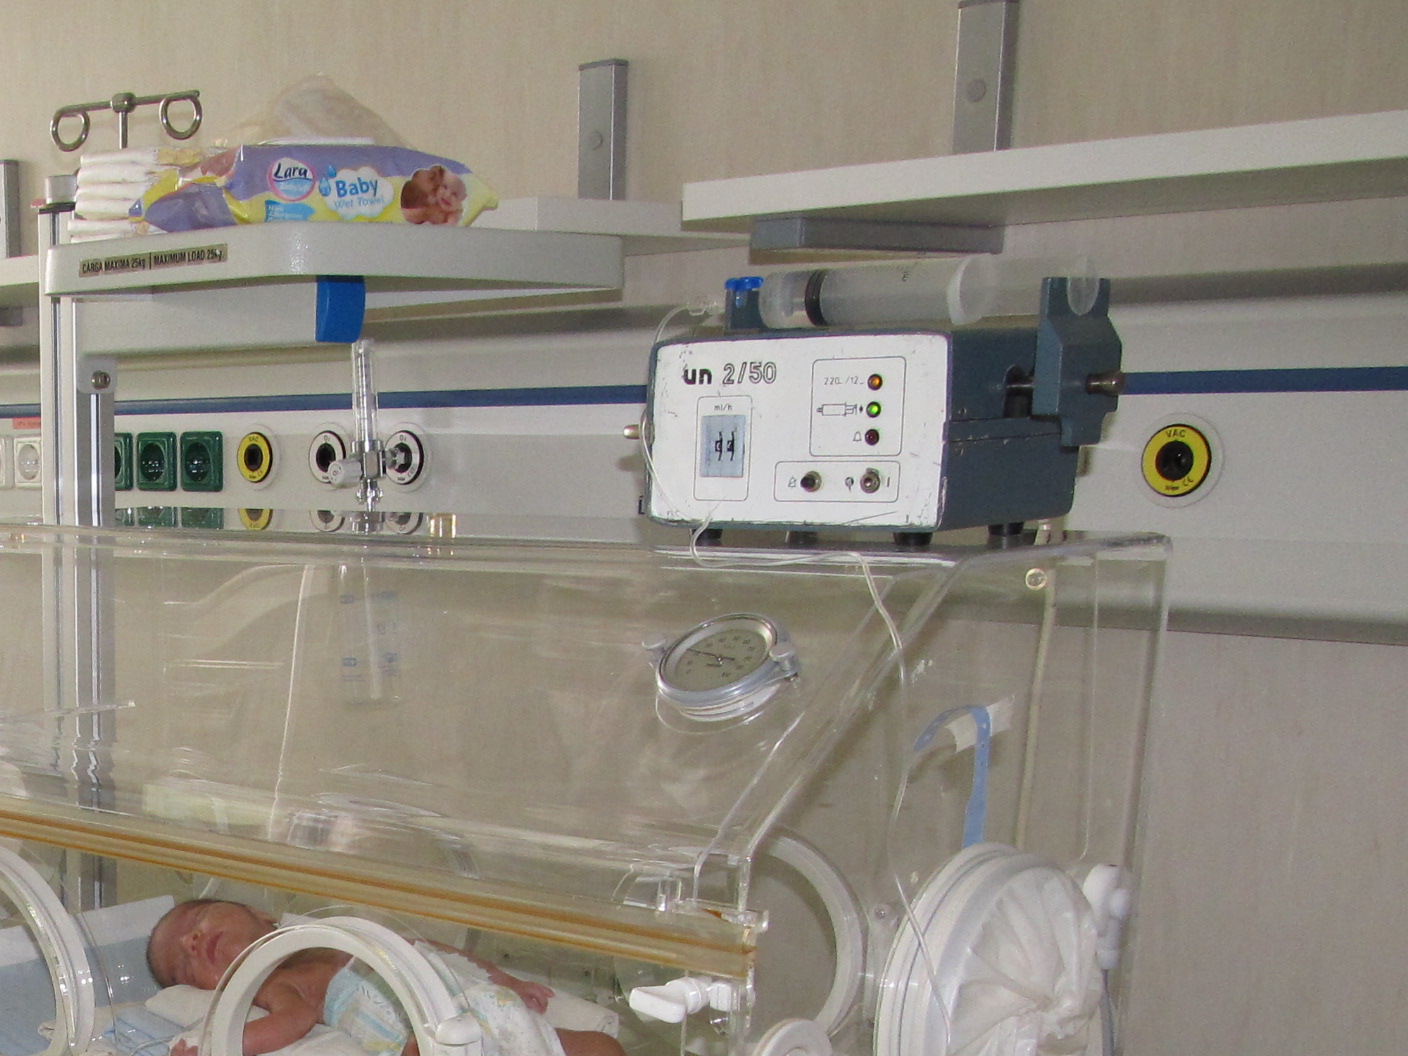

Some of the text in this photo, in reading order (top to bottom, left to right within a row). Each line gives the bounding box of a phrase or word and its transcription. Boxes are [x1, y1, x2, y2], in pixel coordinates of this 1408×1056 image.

[273, 162, 308, 179] Lara
[335, 177, 378, 198] Baby
[82, 262, 103, 273] CARGA
[104, 259, 130, 271] MAXIMA
[153, 252, 186, 266] MAXIMUM
[187, 250, 206, 262] LOAD
[722, 361, 777, 385] 2/50
[1165, 429, 1186, 438] VAC
